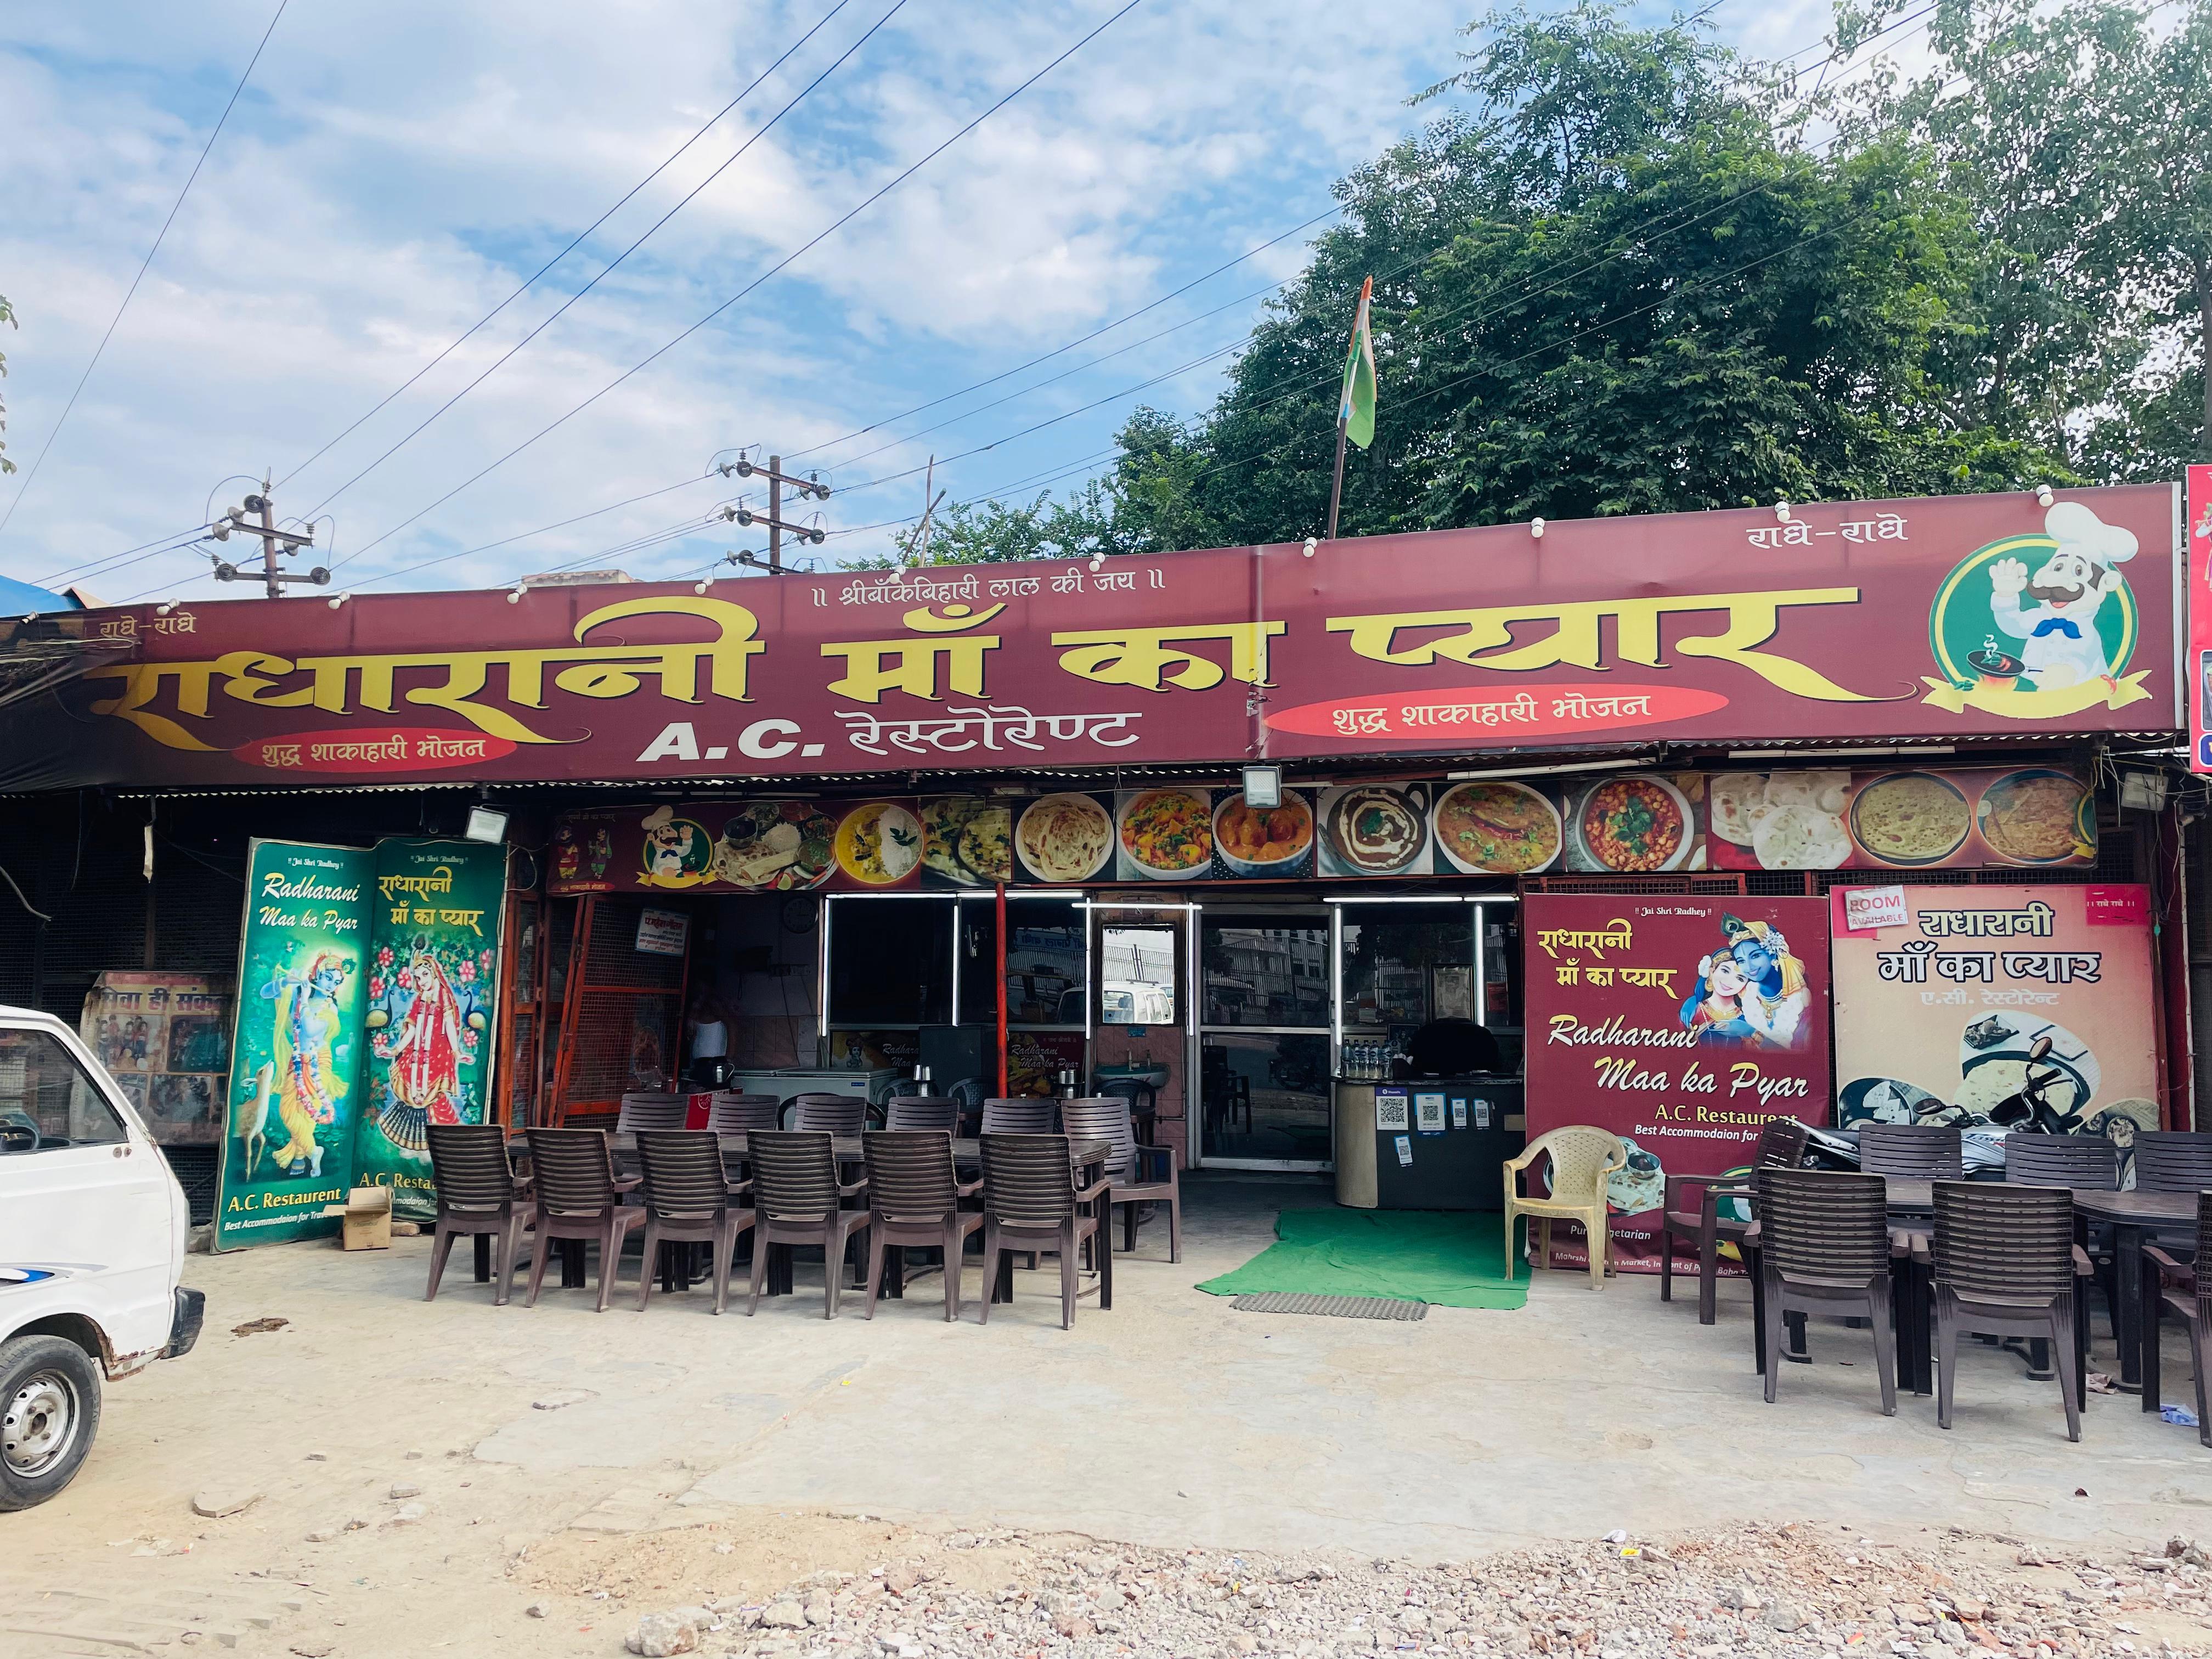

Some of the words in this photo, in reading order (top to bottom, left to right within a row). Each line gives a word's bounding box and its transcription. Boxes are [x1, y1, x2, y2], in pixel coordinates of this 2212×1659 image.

[1746, 512, 1909, 549] राधे-राधे
[989, 576, 1041, 597] लाल
[1049, 567, 1085, 594] की
[1092, 571, 1137, 591] जय
[81, 595, 767, 752] राधारानी
[821, 602, 1008, 704] माँ
[1051, 620, 1288, 692] का
[1325, 587, 1919, 703] प्यार
[1333, 707, 1392, 736] शुद्ध
[1401, 692, 1539, 727] शाकाहारी
[1551, 691, 1652, 719] भोजन
[261, 743, 303, 767] शुद्ध
[311, 734, 409, 763] शाकाहारी
[416, 735, 486, 758] भोजन
[635, 718, 826, 762] A.C.
[292, 857, 302, 866] Jai
[303, 858, 315, 866] Shri
[261, 872, 360, 902] Radharani
[379, 866, 453, 901] राधारानी
[1641, 907, 1654, 917] Jai
[1656, 907, 1673, 915] Shri
[1674, 907, 1706, 917] Radhey
[1850, 895, 1900, 912] ROOM
[2096, 899, 2109, 907] राधे
[2110, 899, 2124, 907] राधे
[259, 906, 296, 927] Maa
[301, 909, 318, 928] ka
[323, 910, 358, 934] Pyar
[390, 900, 410, 926] माँ
[414, 908, 437, 926] का
[439, 909, 485, 937] प्यार
[1852, 913, 1904, 926] AVAILABLE
[1918, 900, 2056, 936] राधारानी
[1537, 918, 1634, 960] राधारानी
[1877, 940, 1939, 983] माँ
[1935, 951, 1996, 983] का
[2001, 952, 2102, 984] प्यार
[1555, 957, 1581, 987] माँ
[1585, 967, 1615, 988] का
[1618, 967, 1682, 1000] प्यार
[148, 988, 171, 1011] ही
[1921, 988, 1974, 1005] ए.सी.
[1547, 1014, 1699, 1049] Radharani
[882, 1043, 919, 1054] Radhara
[1011, 1044, 1059, 1056] Radharani
[1020, 1057, 1041, 1068] Maa
[1044, 1058, 1054, 1068] ka
[1594, 1056, 1671, 1091] Maa
[1680, 1062, 1718, 1093] ka
[1729, 1062, 1809, 1106] Pyar
[1655, 1104, 1691, 1121] A.C.
[1635, 1125, 1657, 1136] Best
[1658, 1126, 1740, 1140] Accommodaion
[1741, 1130, 1758, 1143] for
[393, 1173, 437, 1190] Resta
[228, 1194, 258, 1212] A.C.
[263, 1188, 341, 1209] Restaurent
[393, 1196, 427, 1205] modaion
[224, 1222, 241, 1231] Best
[242, 1215, 297, 1229] Accommodaion
[297, 1212, 309, 1223] for
[1570, 1225, 1587, 1235] Pur
[1610, 1229, 1651, 1240] getarian
[1684, 1262, 1694, 1271] of
